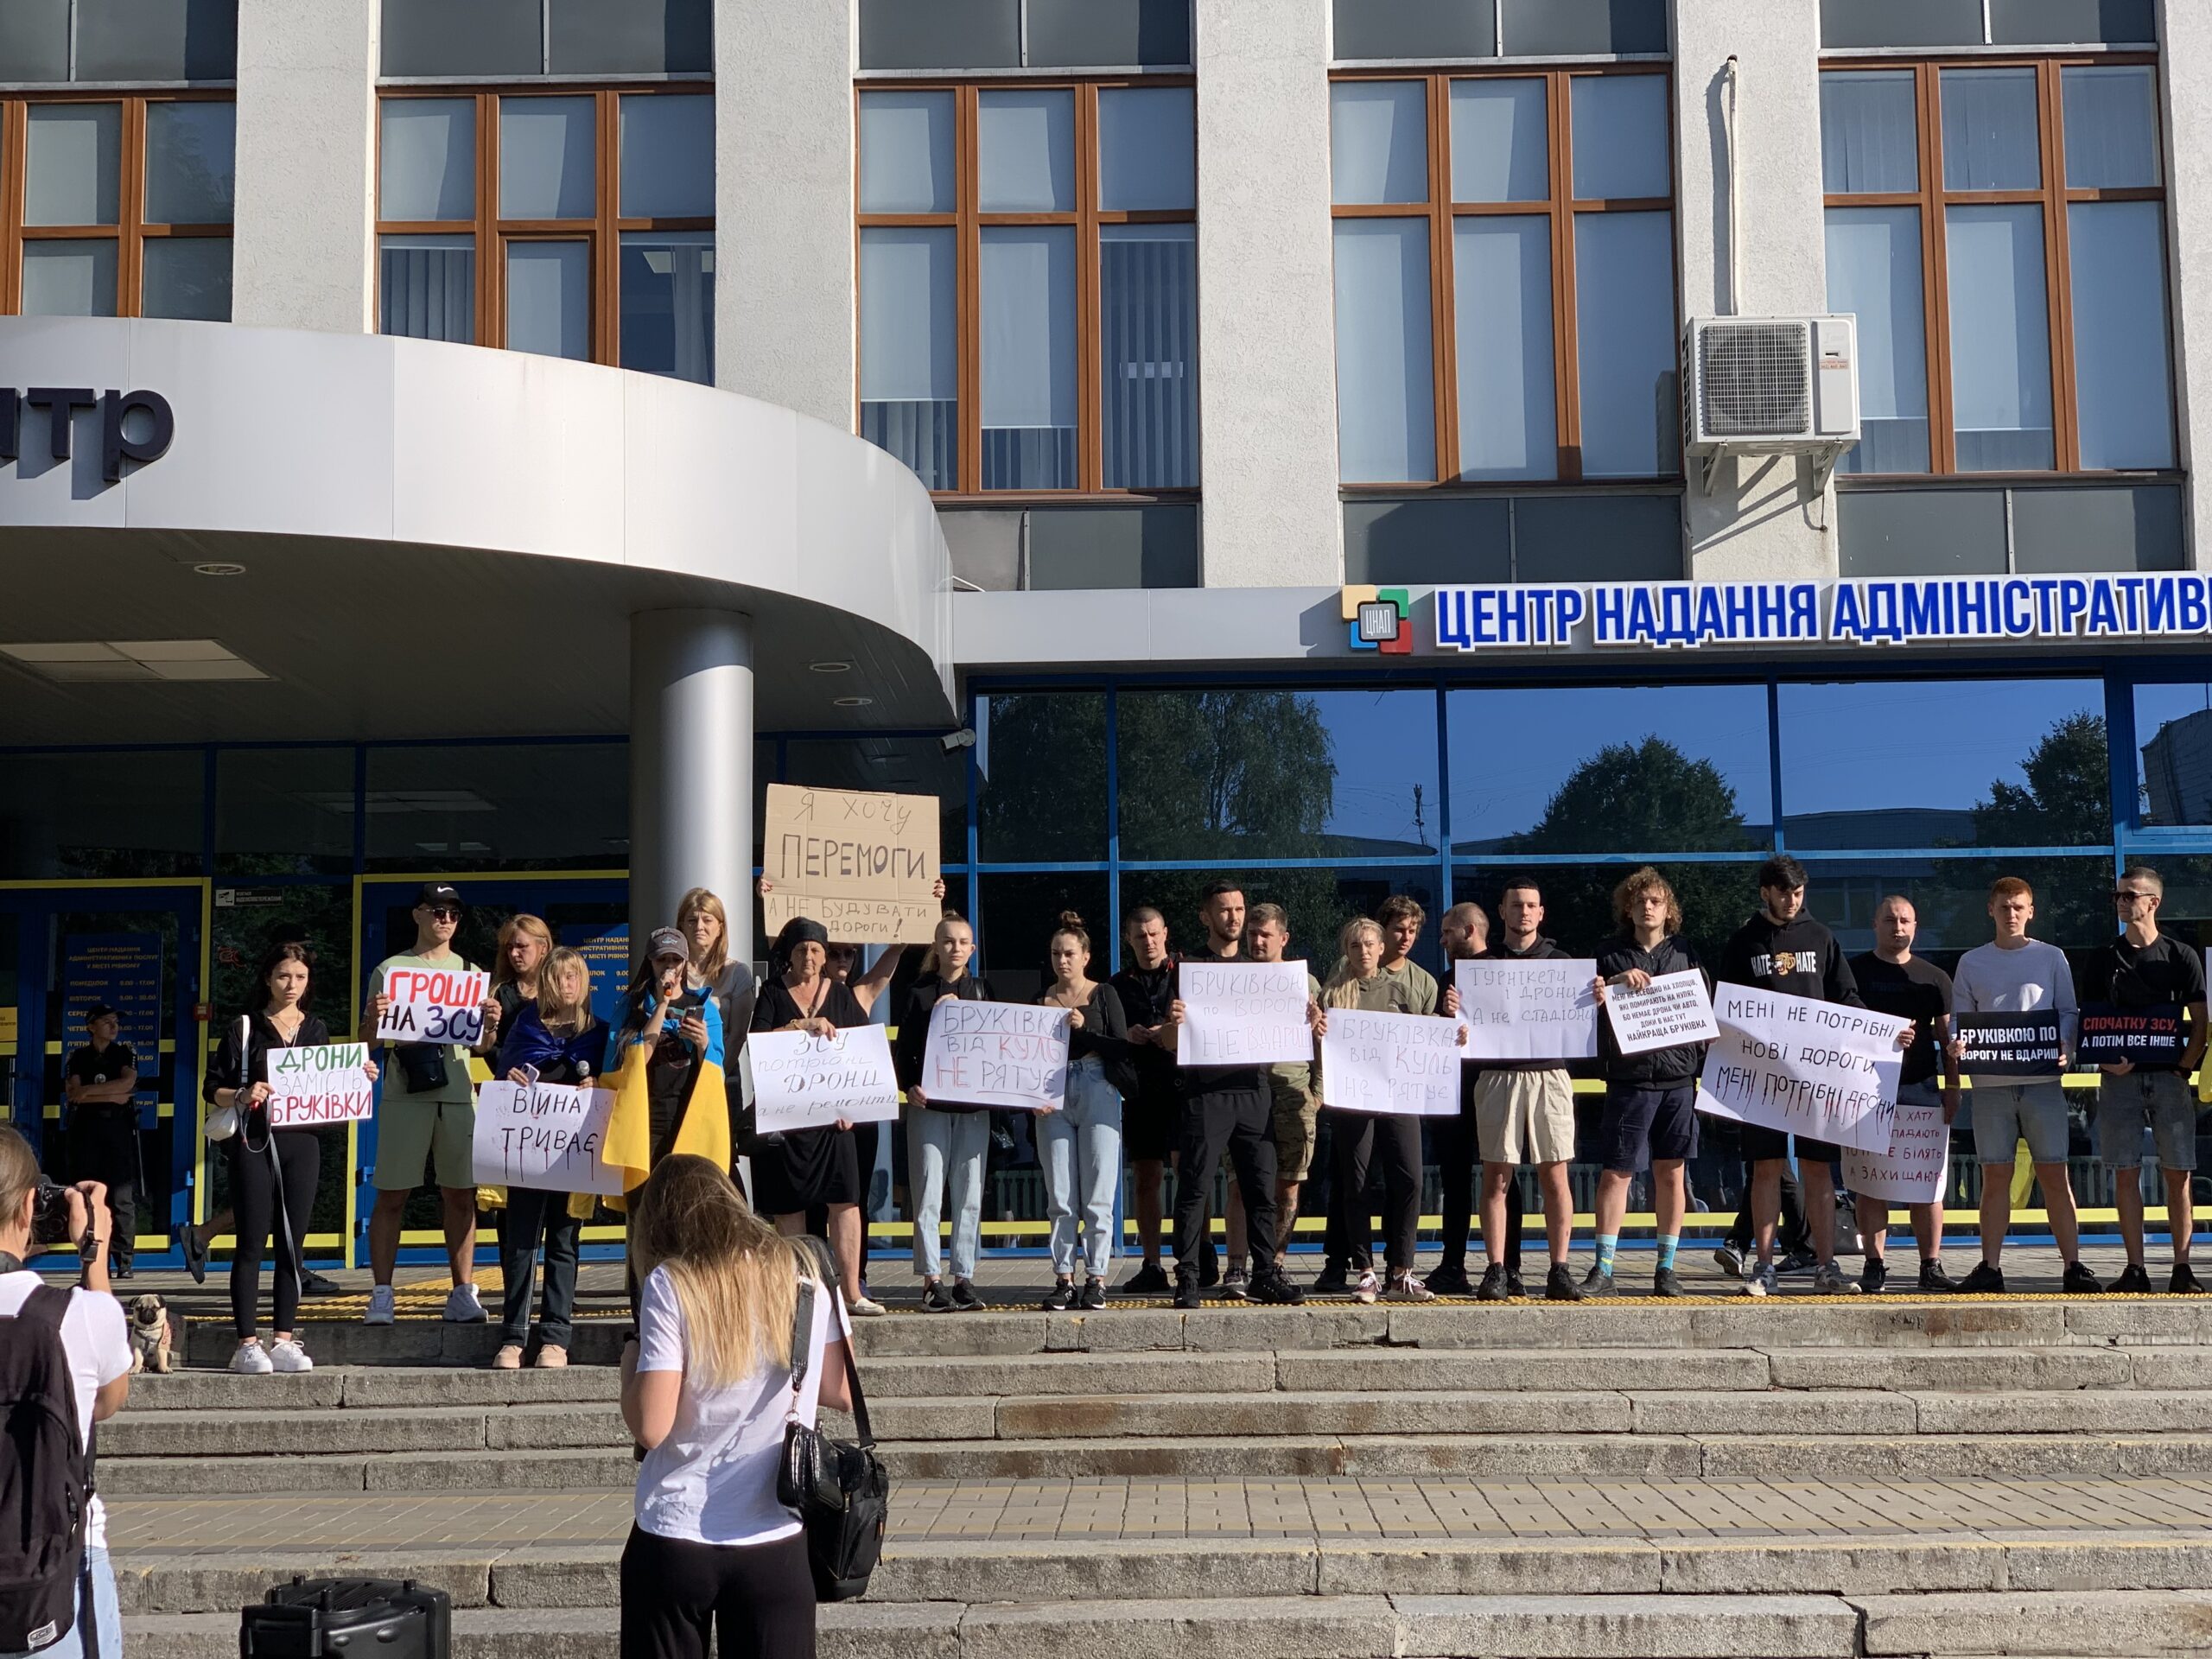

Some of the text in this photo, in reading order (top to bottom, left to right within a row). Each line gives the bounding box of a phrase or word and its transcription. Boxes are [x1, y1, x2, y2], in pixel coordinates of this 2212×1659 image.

[0, 387, 175, 482] тр
[1365, 609, 1391, 637] ЦНАП
[1437, 576, 2212, 650] ЦЕНТР НАДАННЯ АДМІНІСТРАТИВ
[794, 792, 912, 835] Я ХОЧУ
[781, 833, 925, 879] ПЕРЕМОГИ
[768, 895, 927, 918] А НЕ БУДУВАТИ
[1751, 951, 1816, 977] HATE HATE
[390, 971, 482, 1007] ГРОШІ
[1192, 970, 1305, 997] БРУКІВКОЮ
[1627, 989, 1636, 999] НЕ
[1663, 983, 1672, 992] НА
[1472, 1007, 1484, 1026] А
[1618, 1002, 1630, 1011] ЯКІ
[1630, 996, 1667, 1009] ПОМИРАЮТЬ
[1623, 1013, 1631, 1021] БО
[1653, 1006, 1672, 1016] ДРОНА
[381, 1005, 485, 1042] НА ЗСУ
[944, 1005, 1064, 1040] БРУКІВКА
[1343, 1019, 1455, 1048] БРУКІВКА
[1627, 1020, 1707, 1042] НАЙКРАЩА БРУКІВКА
[1640, 1020, 1657, 1029] ДОКИ
[1662, 1015, 1675, 1024] НАС
[1728, 1000, 1896, 1039] МЕНІ НЕ ПОТРІБНІ
[2083, 1017, 2177, 1033] СПОЧАТКУ ЗСУ,
[793, 1032, 849, 1055] ЗСУ
[1203, 1028, 1240, 1058] НЕ
[1960, 1026, 2056, 1044] БРУКІВКОЮ ПО
[2082, 1034, 2176, 1048] А ПОТІМ ВСЕ ІНШЕ
[276, 1045, 362, 1074] ДРОНИ
[947, 1036, 1061, 1064] ВІД КУЛЬ
[1395, 1046, 1452, 1076] КУЛЬ
[1742, 1039, 1875, 1075] НОВІ ДОРОГИ
[2000, 1050, 2014, 1060] НЕ
[2016, 1048, 2058, 1062] ВДАРИШ
[277, 1070, 363, 1097] ЗАМІСТЬ
[937, 1055, 1057, 1093] НЕ РЯТУЄ
[513, 1087, 581, 1116] ВІЙНА
[1388, 1077, 1449, 1101] РЯТУЄ
[1715, 1065, 1896, 1127] МЕНІ ПОТРІБНІ ДРОНИ
[270, 1090, 372, 1123] БРУКІВКИ
[1906, 1111, 1935, 1122] ХАТУ
[501, 1126, 598, 1163] ТРИВАЄ
